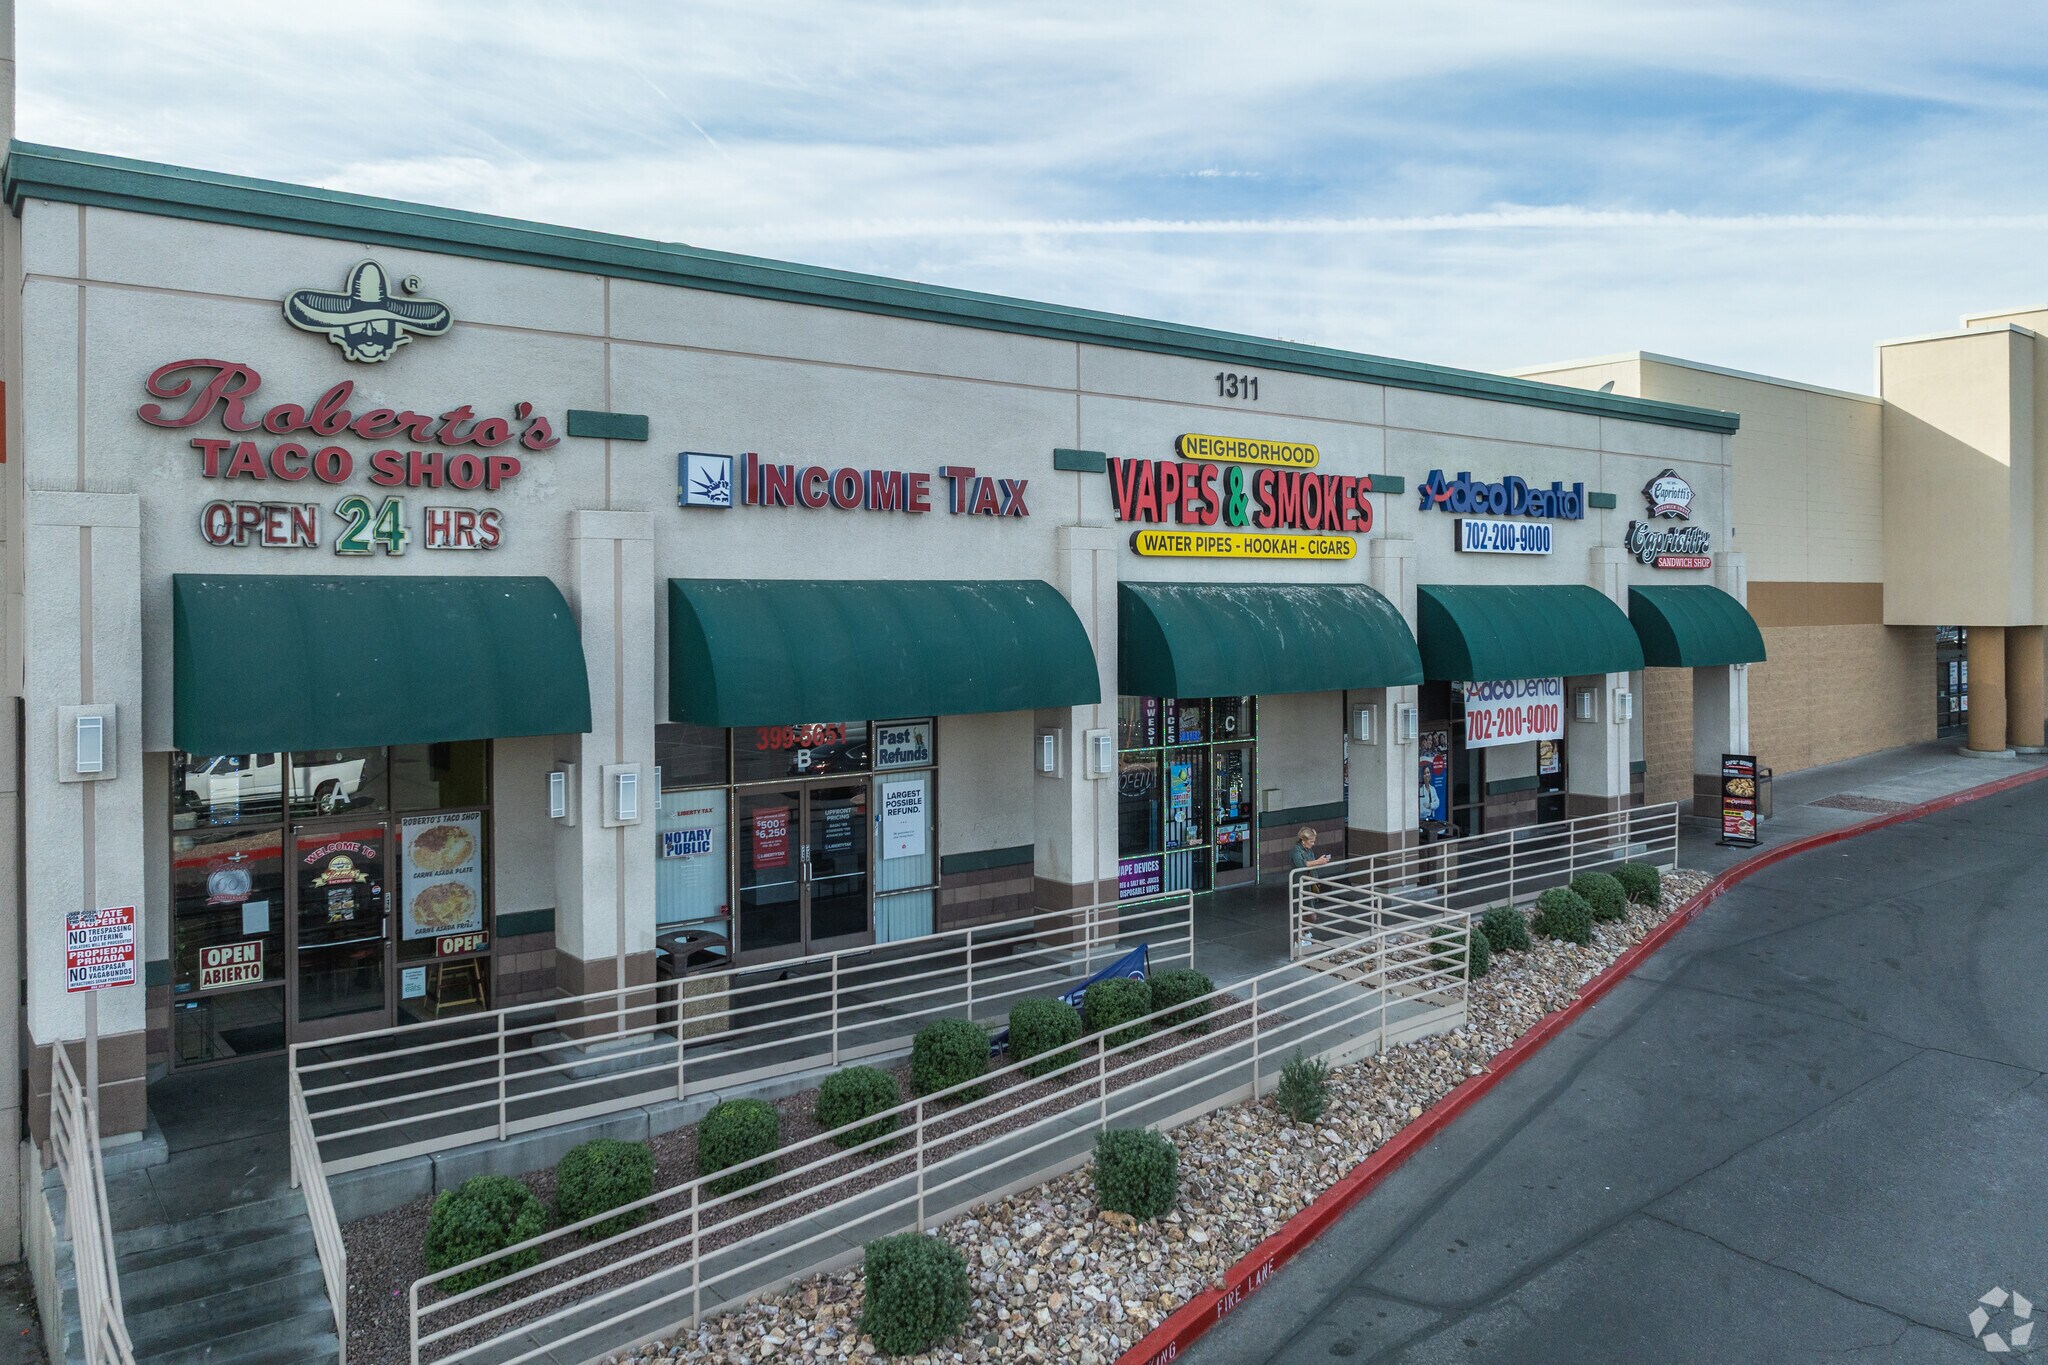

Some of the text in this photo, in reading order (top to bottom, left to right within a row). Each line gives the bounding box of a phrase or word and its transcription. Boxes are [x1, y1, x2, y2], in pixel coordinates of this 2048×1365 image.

[1215, 372, 1258, 400] 1311
[137, 358, 561, 451] Roberto's
[1186, 437, 1315, 464] NEIGHBORHOOD
[190, 438, 522, 490] TACO SHOP
[741, 452, 1030, 517] INCOME TAX
[1107, 457, 1374, 533] VAPES & SMOKES
[201, 496, 502, 556] OPEN 24 HRS
[1465, 521, 1551, 552] 702-200-9000
[1144, 535, 1192, 552] WATER
[1196, 536, 1232, 553] PIPES
[1244, 538, 1298, 554] HOOKAH
[1308, 540, 1350, 555] CIGARS
[1658, 557, 1711, 568] SANDWICH SHOP
[1146, 697, 1156, 745] OWEST
[1167, 698, 1176, 743] RICES
[1225, 716, 1236, 732] C
[1467, 703, 1559, 742] 702-200-9000
[756, 722, 847, 751] 399-5651
[879, 728, 911, 746] Fast
[797, 749, 812, 768] B
[879, 747, 928, 764] Refunds
[329, 781, 350, 804] A
[887, 790, 921, 800] LARGEST
[886, 798, 922, 808] POSSIBLE
[888, 806, 921, 816] REFUND.
[403, 812, 480, 826] ROBERTO'S TACO SHOP
[825, 808, 852, 816] UPFRONT
[756, 820, 779, 830] $500
[664, 829, 711, 844] NOTARY
[755, 828, 787, 839] $6,250
[304, 842, 377, 865] WELCOME TO
[666, 841, 710, 856] PUBLIC
[413, 871, 433, 879] CARNE
[1134, 860, 1160, 874] DEVICES
[1120, 884, 1160, 898] DISPOSABLE VAPES
[69, 930, 87, 945] NO
[88, 924, 132, 935] TRESPASSING
[89, 933, 124, 942] LOITERING
[415, 927, 434, 935] CARNE
[436, 924, 455, 932] ASADA
[69, 945, 132, 959] PROPIEDAD
[442, 934, 483, 954] OPEN
[76, 953, 125, 966] PRIVADA
[207, 945, 256, 966] OPEN
[69, 967, 87, 982] NO
[89, 962, 126, 972] TRASPASAR
[89, 968, 132, 979] VAGABUNDOS
[203, 964, 260, 985] ABIERTO
[1217, 1257, 1275, 1318] FIRE LANE
